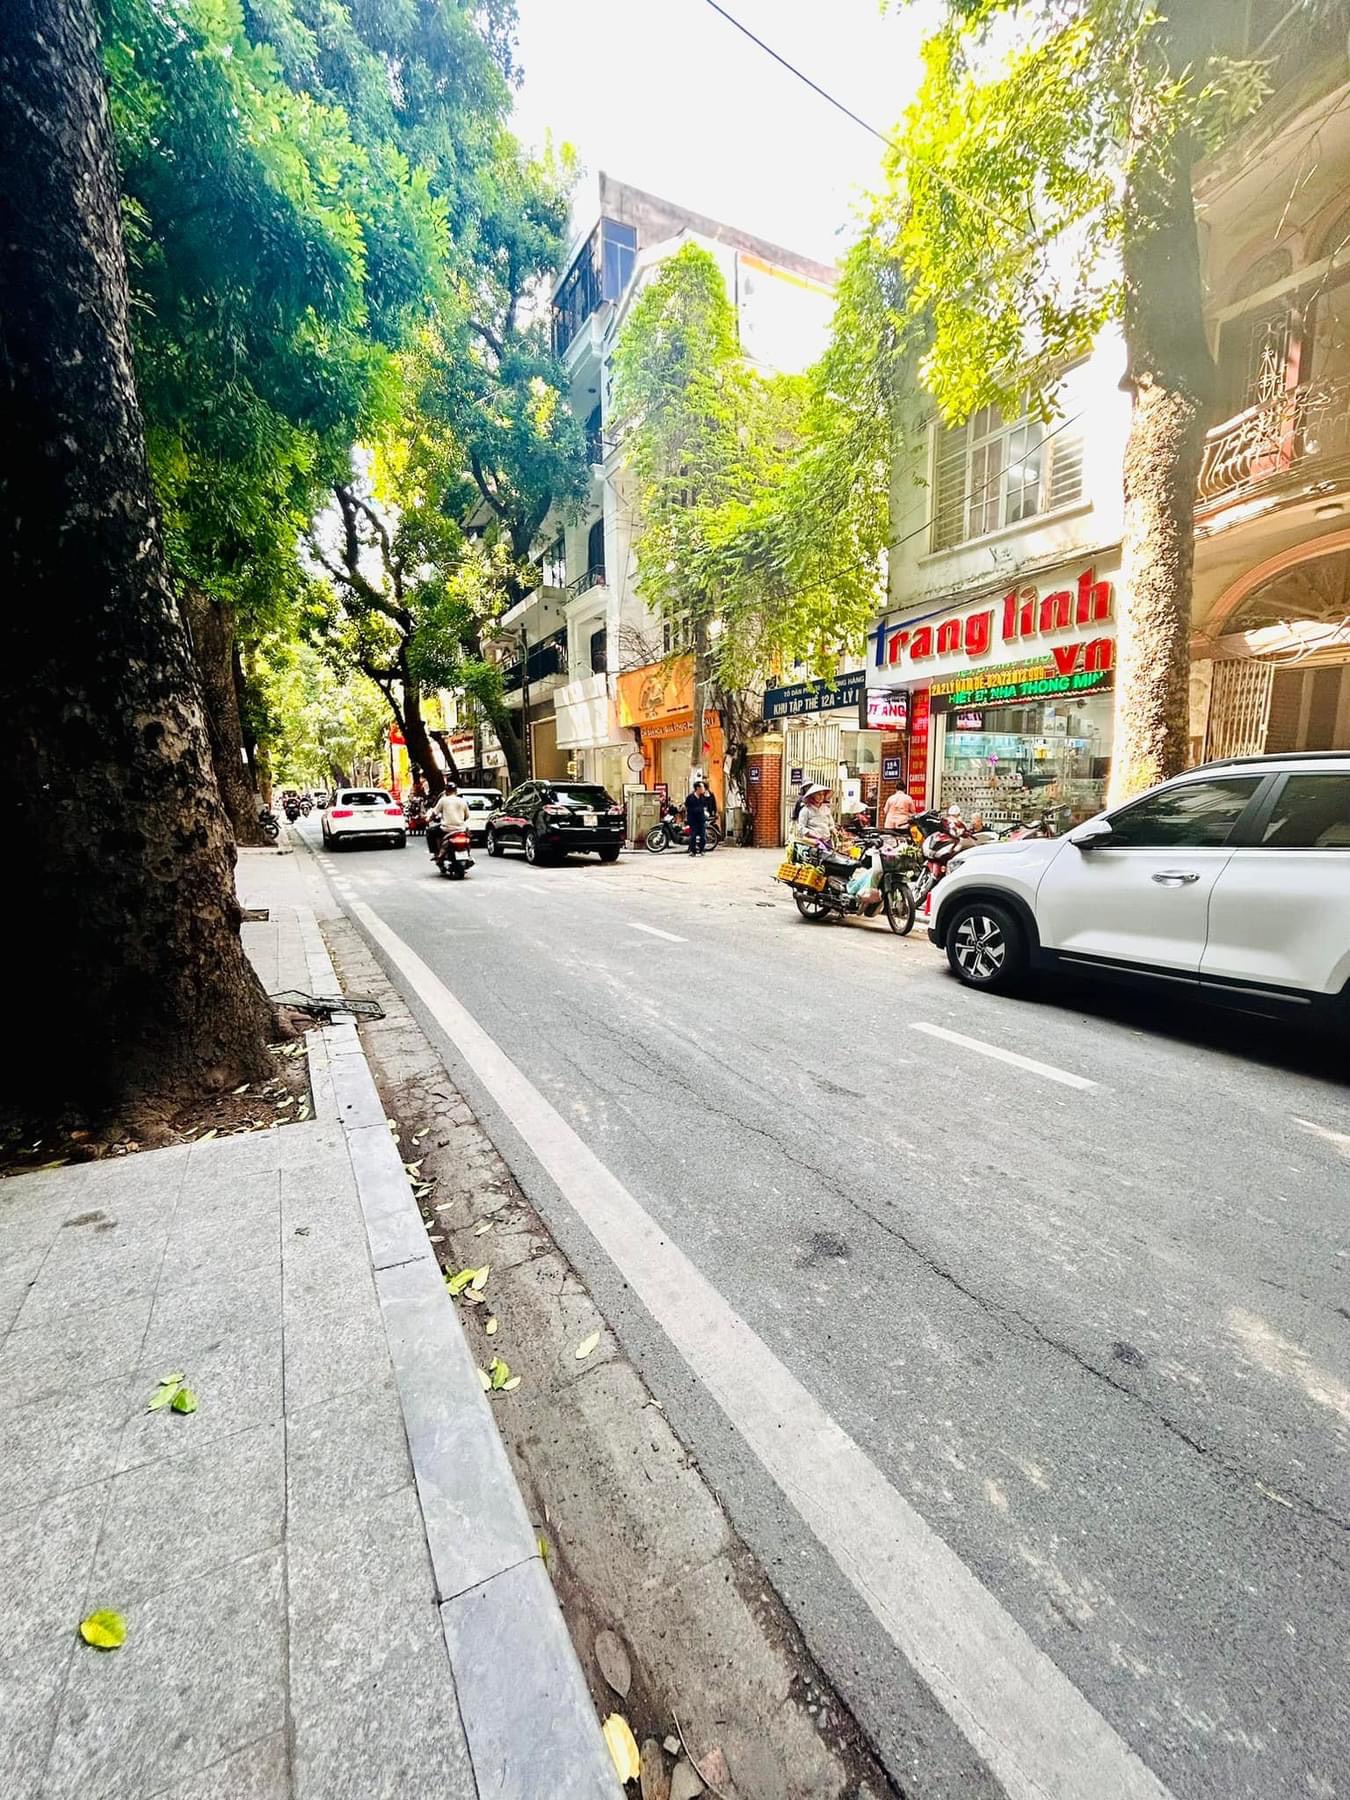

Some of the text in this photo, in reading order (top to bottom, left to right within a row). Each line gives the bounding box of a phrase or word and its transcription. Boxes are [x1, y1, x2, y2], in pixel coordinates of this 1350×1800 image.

[867, 567, 1113, 668] trang linh
[773, 702, 788, 715] KHU
[821, 693, 836, 707] 12A
